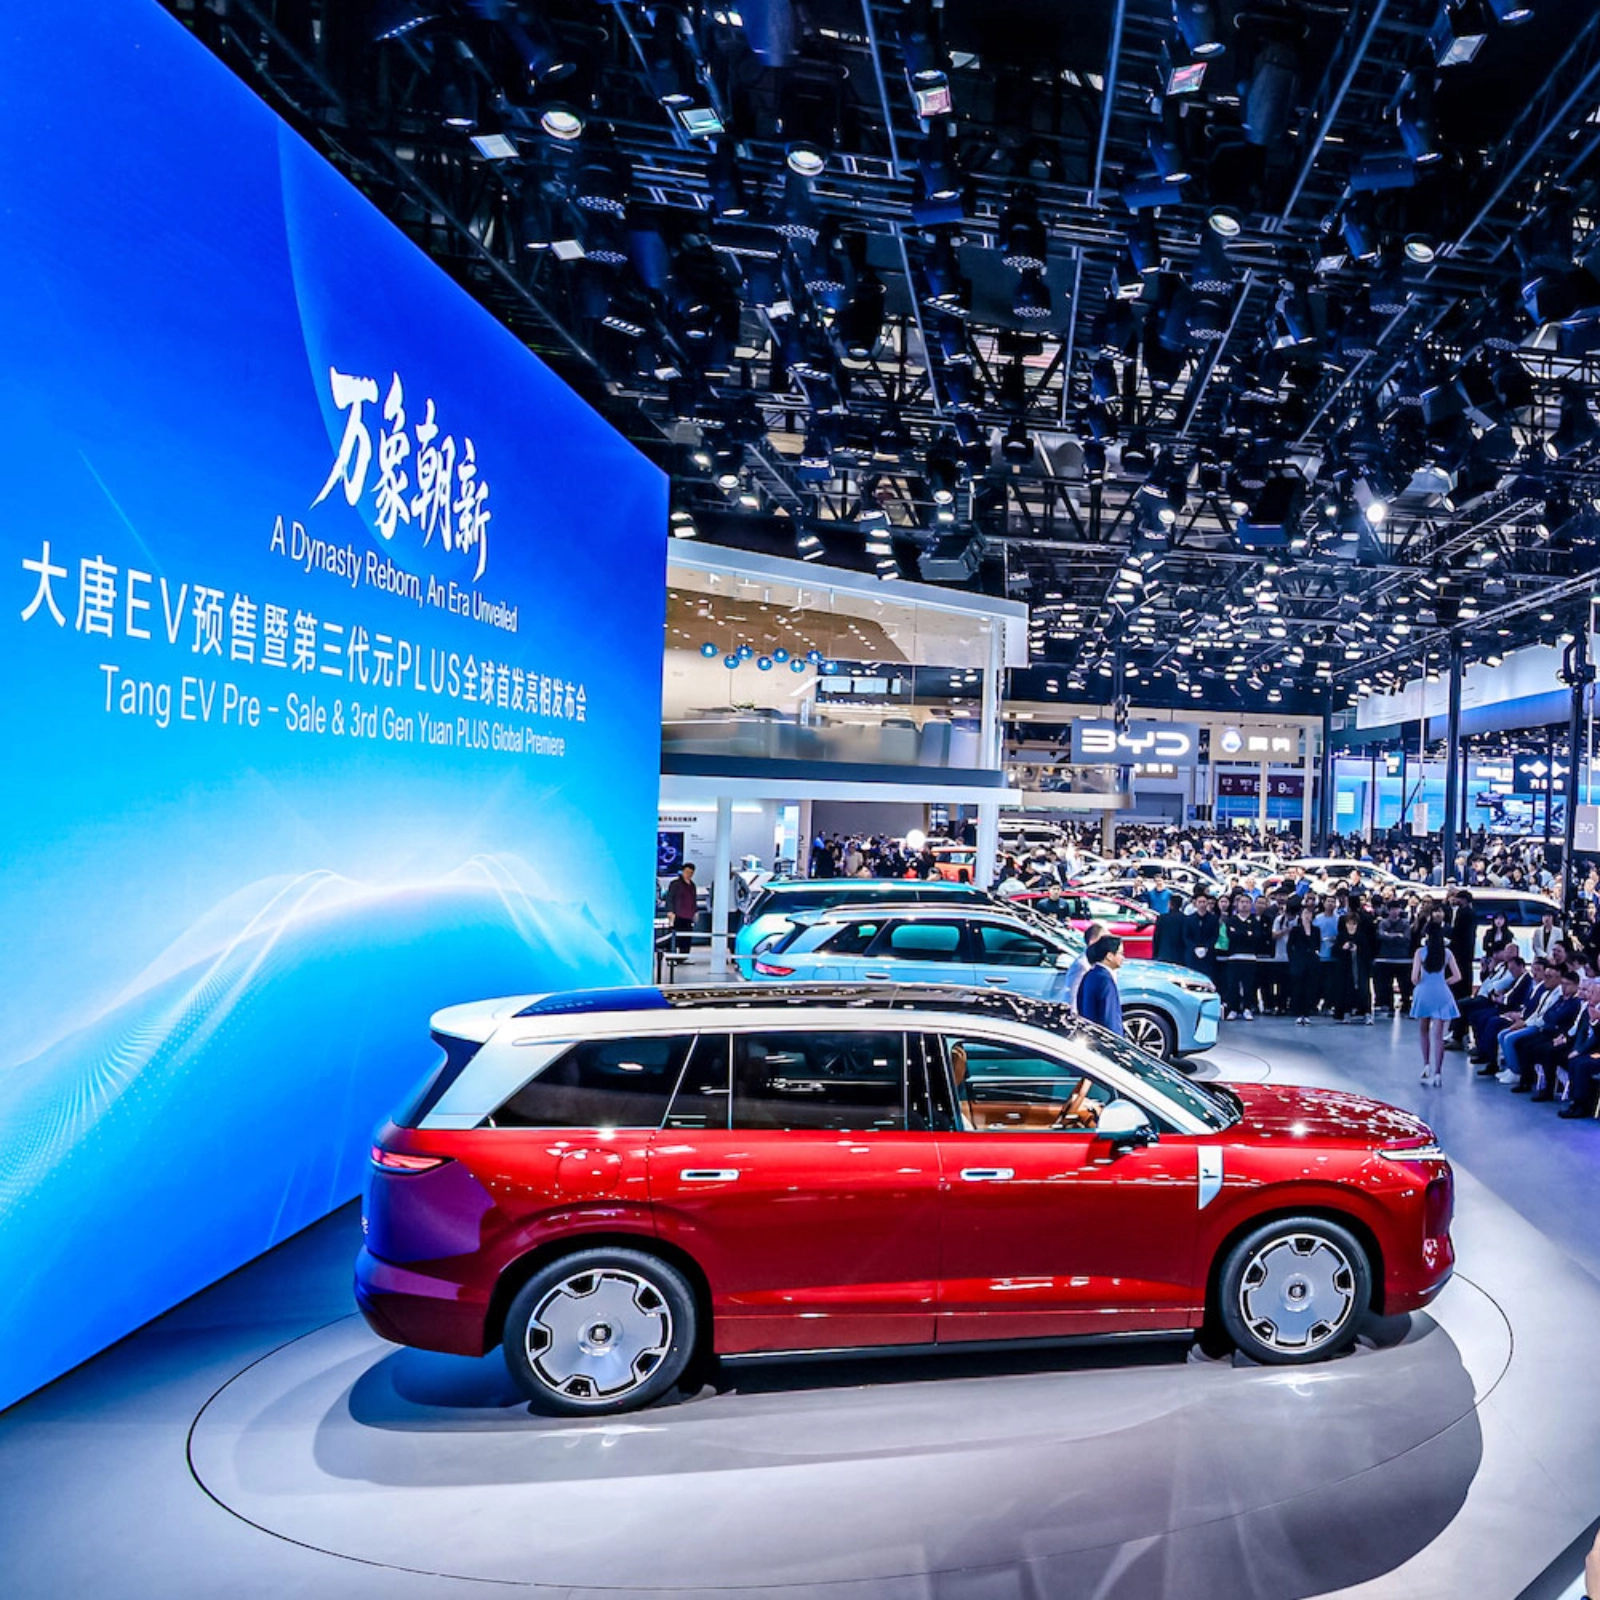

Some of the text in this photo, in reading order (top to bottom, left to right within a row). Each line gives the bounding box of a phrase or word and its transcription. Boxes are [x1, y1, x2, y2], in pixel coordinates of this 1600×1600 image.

[311, 366, 492, 582] 万象朝新
[20, 541, 587, 722] 大唐EV预售暨第三代元PLUS全球首发亮相发布会
[269, 515, 518, 633] A Dynasty Reborn, An Era Unveiled
[99, 664, 171, 728] Tang
[181, 676, 216, 722] EV
[223, 683, 260, 727] Pre
[286, 692, 326, 734] Sale
[331, 699, 345, 735] &
[350, 702, 378, 738] 3rd
[382, 707, 414, 741] Gen
[418, 712, 453, 744] Yuan
[457, 717, 489, 749] PLUS
[492, 722, 524, 752] Global
[526, 727, 565, 756] Premiere
[1081, 729, 1190, 756] BYD
